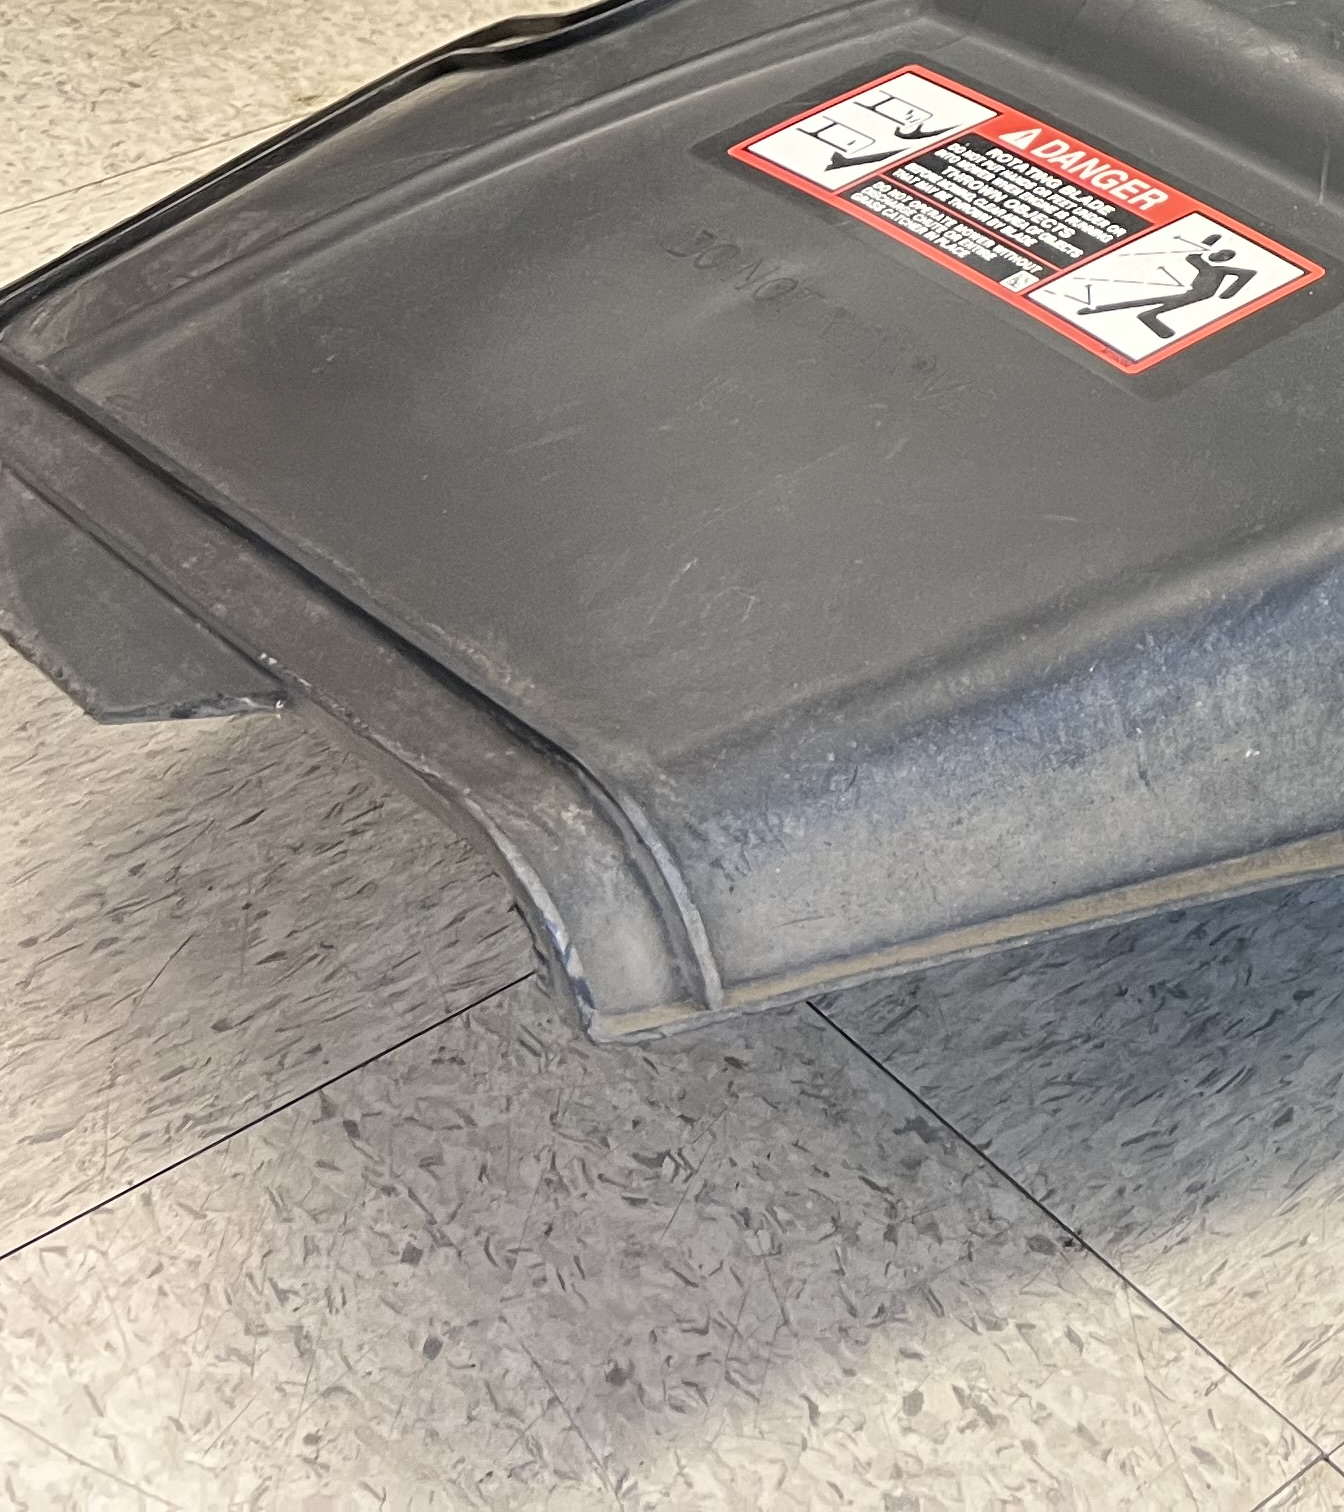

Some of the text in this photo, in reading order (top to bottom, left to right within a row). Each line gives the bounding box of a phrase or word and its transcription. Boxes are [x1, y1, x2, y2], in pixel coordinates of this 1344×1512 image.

[941, 165, 1076, 239] THROWN OBJECTS
[947, 142, 1127, 238] DO NOT PUT HANDS OR FEET UNDER OR
[985, 148, 1116, 216] ROTATING BLADE
[1032, 137, 1169, 211] DANGER
